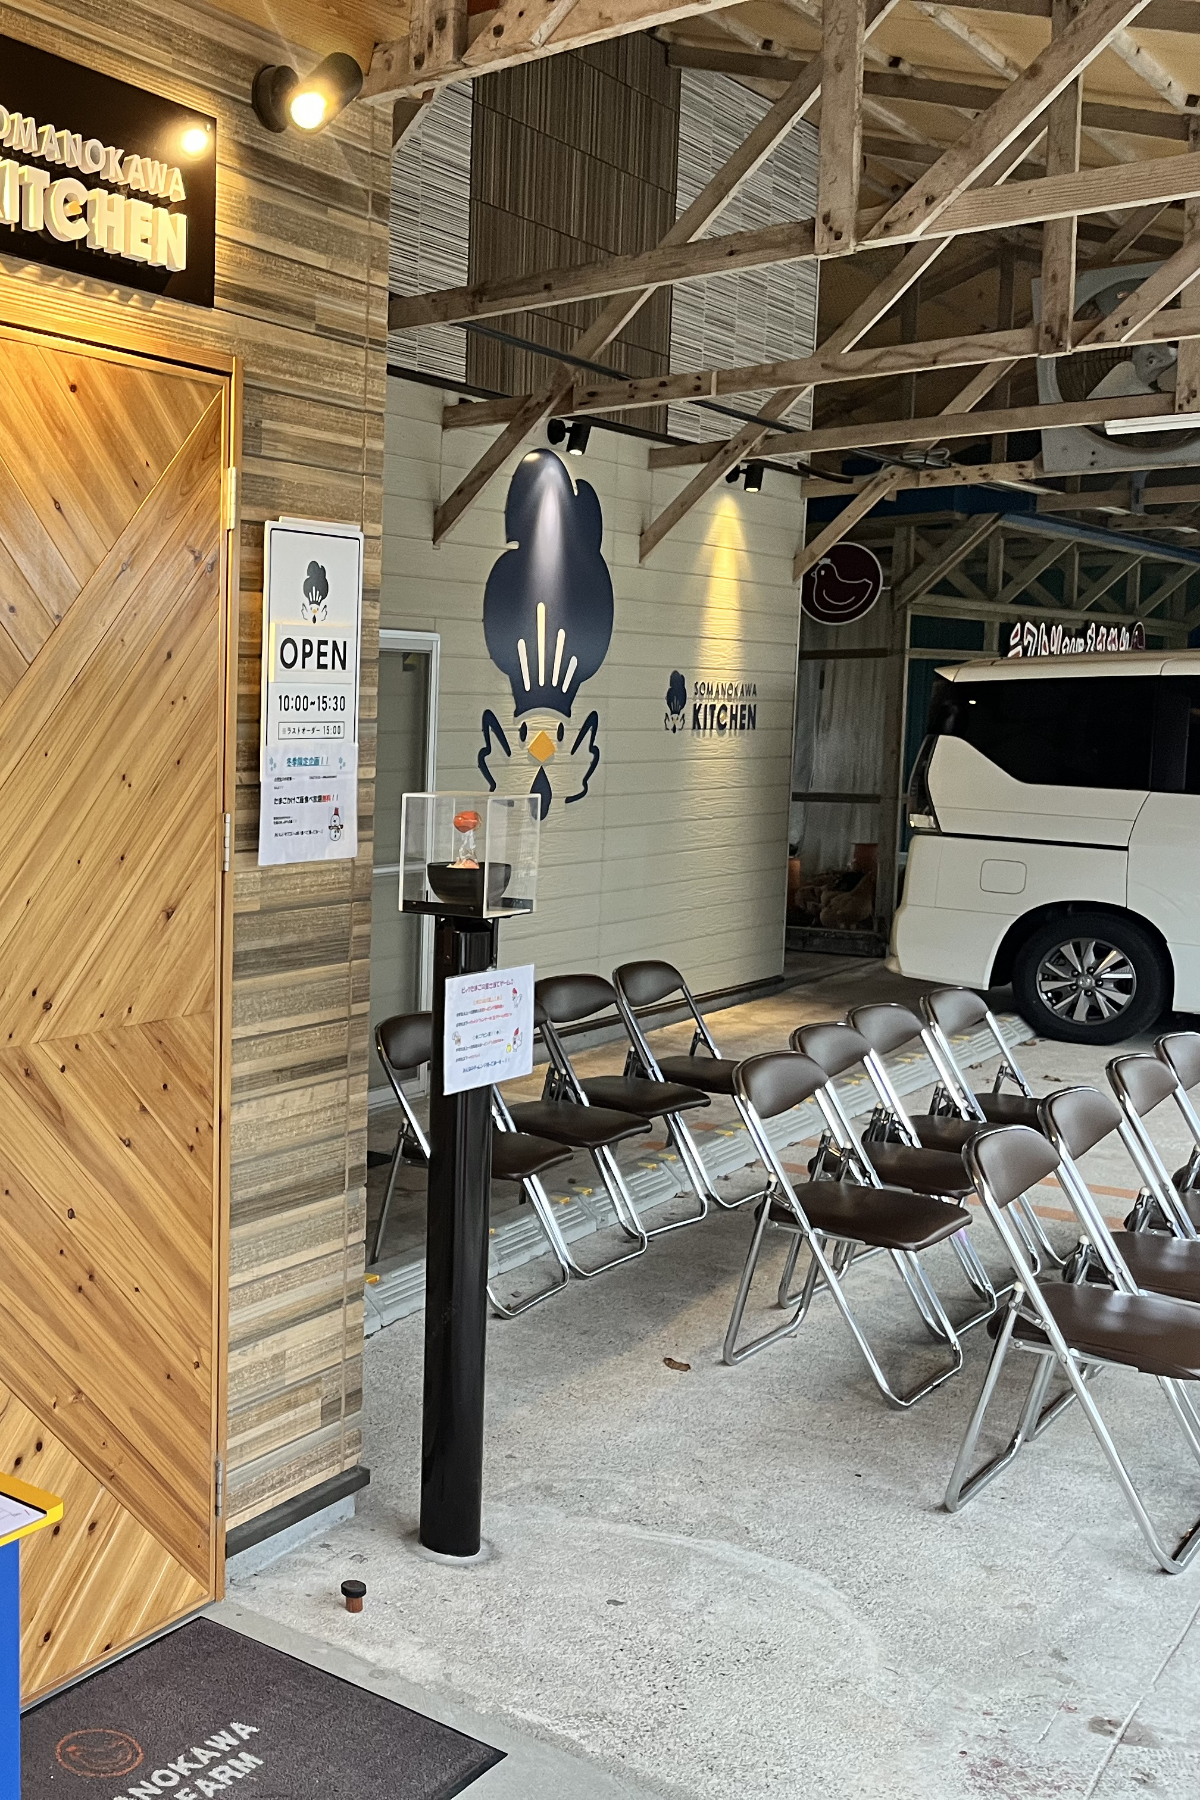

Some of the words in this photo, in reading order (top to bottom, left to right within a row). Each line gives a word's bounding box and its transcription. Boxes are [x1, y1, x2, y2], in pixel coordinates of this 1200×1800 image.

[279, 637, 348, 671] OPEN
[694, 681, 757, 698] SOMANOKAWA
[691, 703, 757, 731] KITCHEN
[323, 725, 342, 735] 15:00
